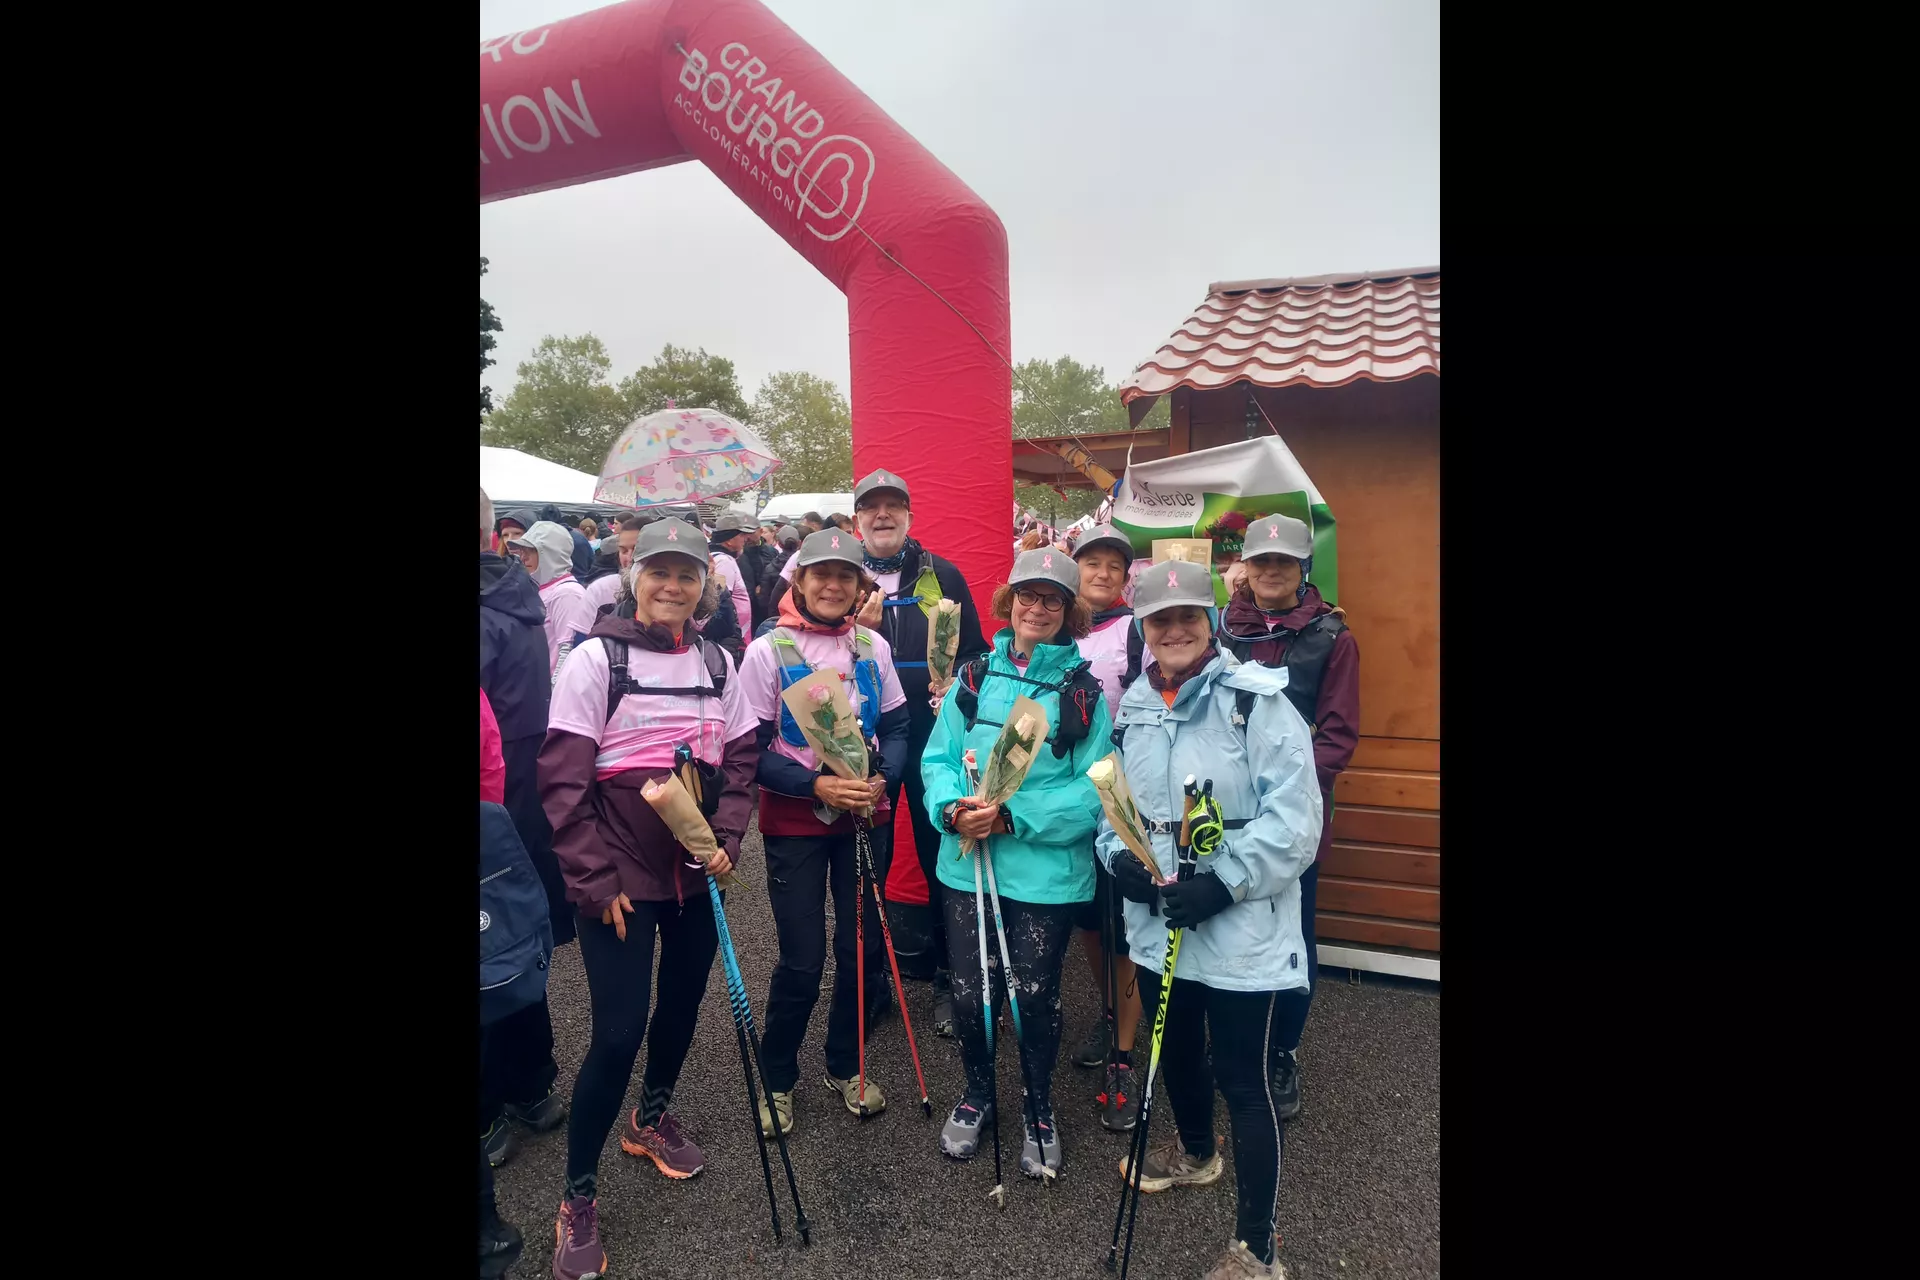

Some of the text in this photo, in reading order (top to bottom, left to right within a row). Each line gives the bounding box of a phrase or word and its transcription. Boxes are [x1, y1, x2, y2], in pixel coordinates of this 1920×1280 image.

[480, 78, 602, 164] ION
[678, 47, 801, 178] BOURG
[719, 42, 825, 139] GRAND
[674, 92, 795, 212] AGGLOMÉRATION
